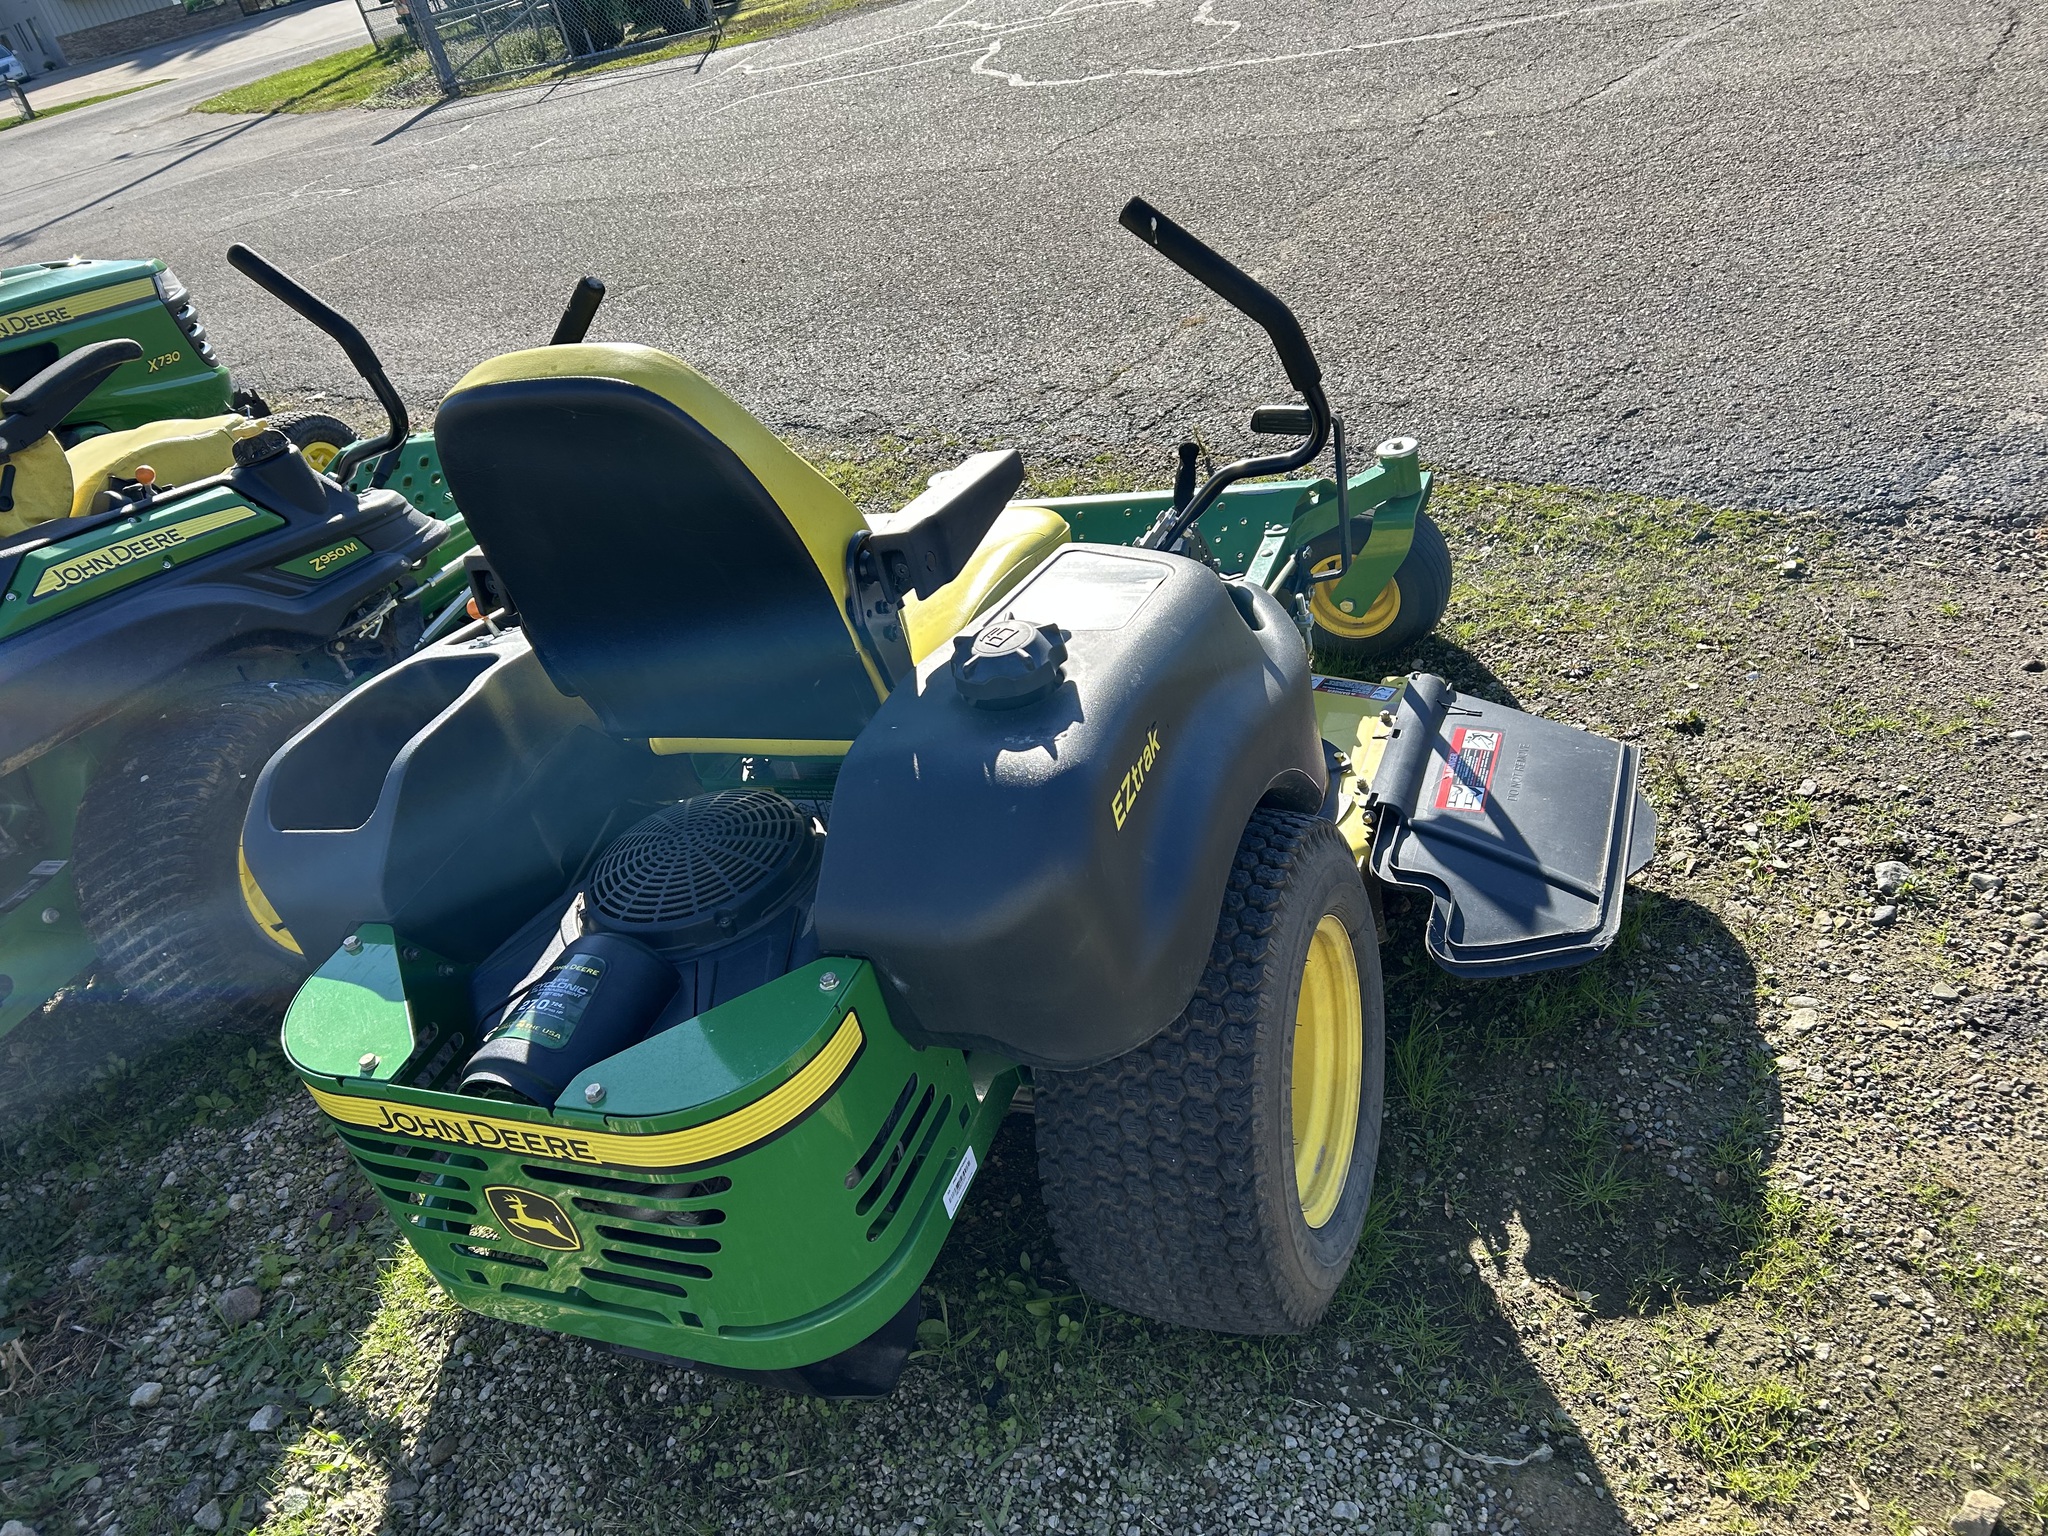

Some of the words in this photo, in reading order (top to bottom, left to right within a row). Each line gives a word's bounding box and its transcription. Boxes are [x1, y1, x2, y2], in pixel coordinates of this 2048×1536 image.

[7, 306, 72, 332] DEERE
[147, 350, 182, 374] X730
[52, 552, 115, 588] JOHN
[115, 528, 186, 562] DEERE
[309, 541, 360, 573] Z950M
[1111, 728, 1161, 832] EZtrak
[1511, 772, 1522, 789] NOT
[1507, 789, 1519, 802] DO
[569, 963, 600, 977] DEERE
[532, 981, 588, 995] CYCLONIC
[517, 998, 551, 1012] 27.0
[542, 1028, 561, 1040] USA
[377, 1104, 469, 1144] JOHN
[473, 1118, 599, 1162] DEERE
